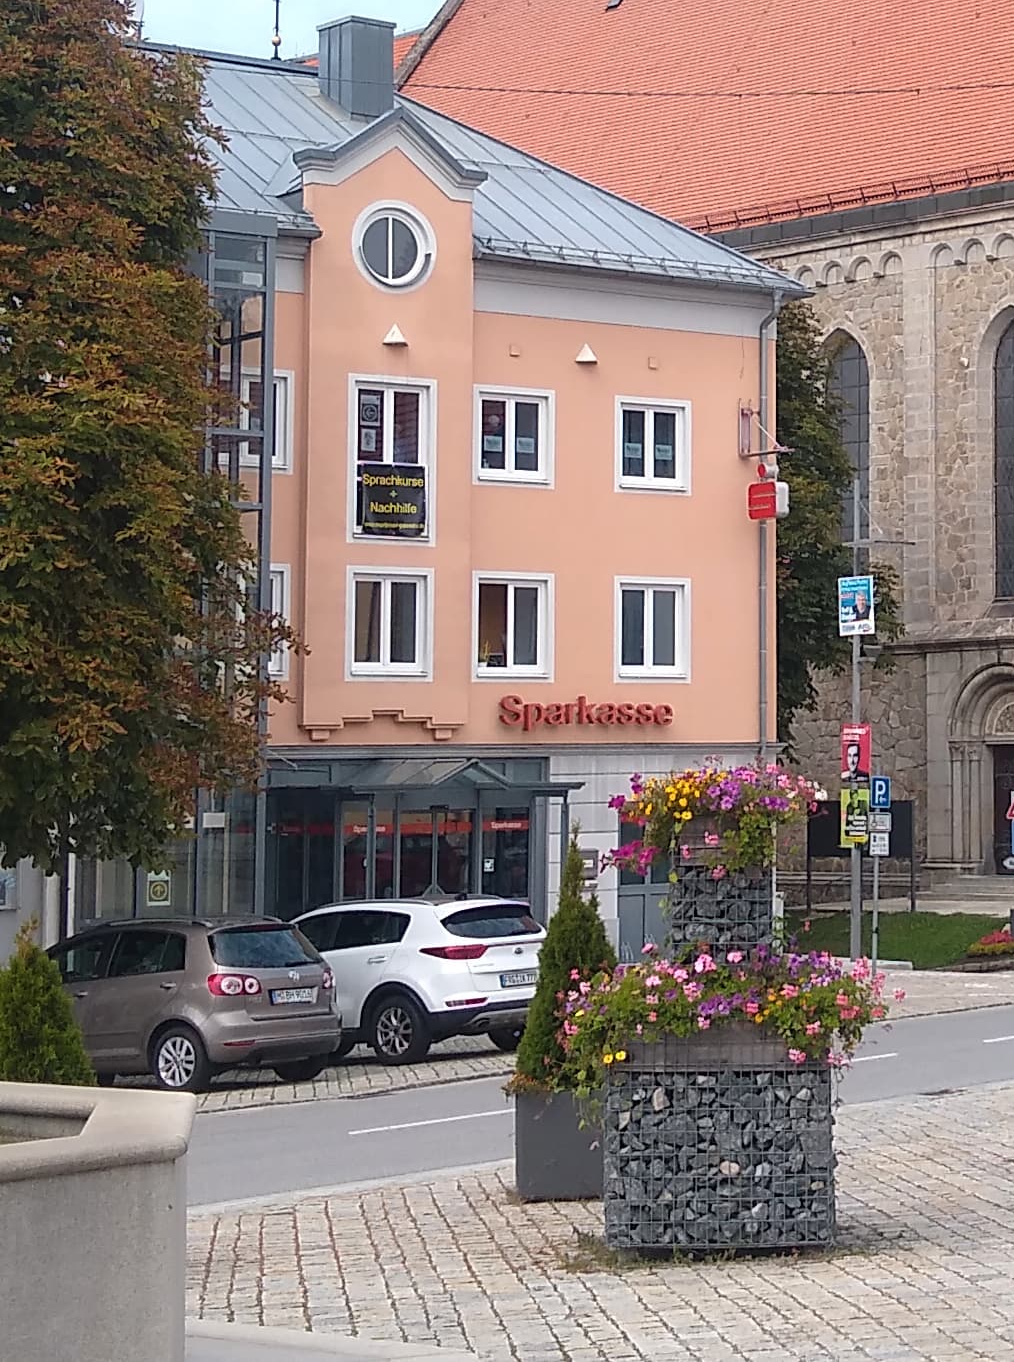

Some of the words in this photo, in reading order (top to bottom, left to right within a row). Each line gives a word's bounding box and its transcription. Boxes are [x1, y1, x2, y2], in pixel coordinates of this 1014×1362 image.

[362, 473, 424, 487] Sprachkurse
[370, 502, 417, 514] Nachhilfe
[499, 694, 673, 732] Sparkasse
[875, 780, 886, 804] P
[490, 821, 522, 830] Sparkasse
